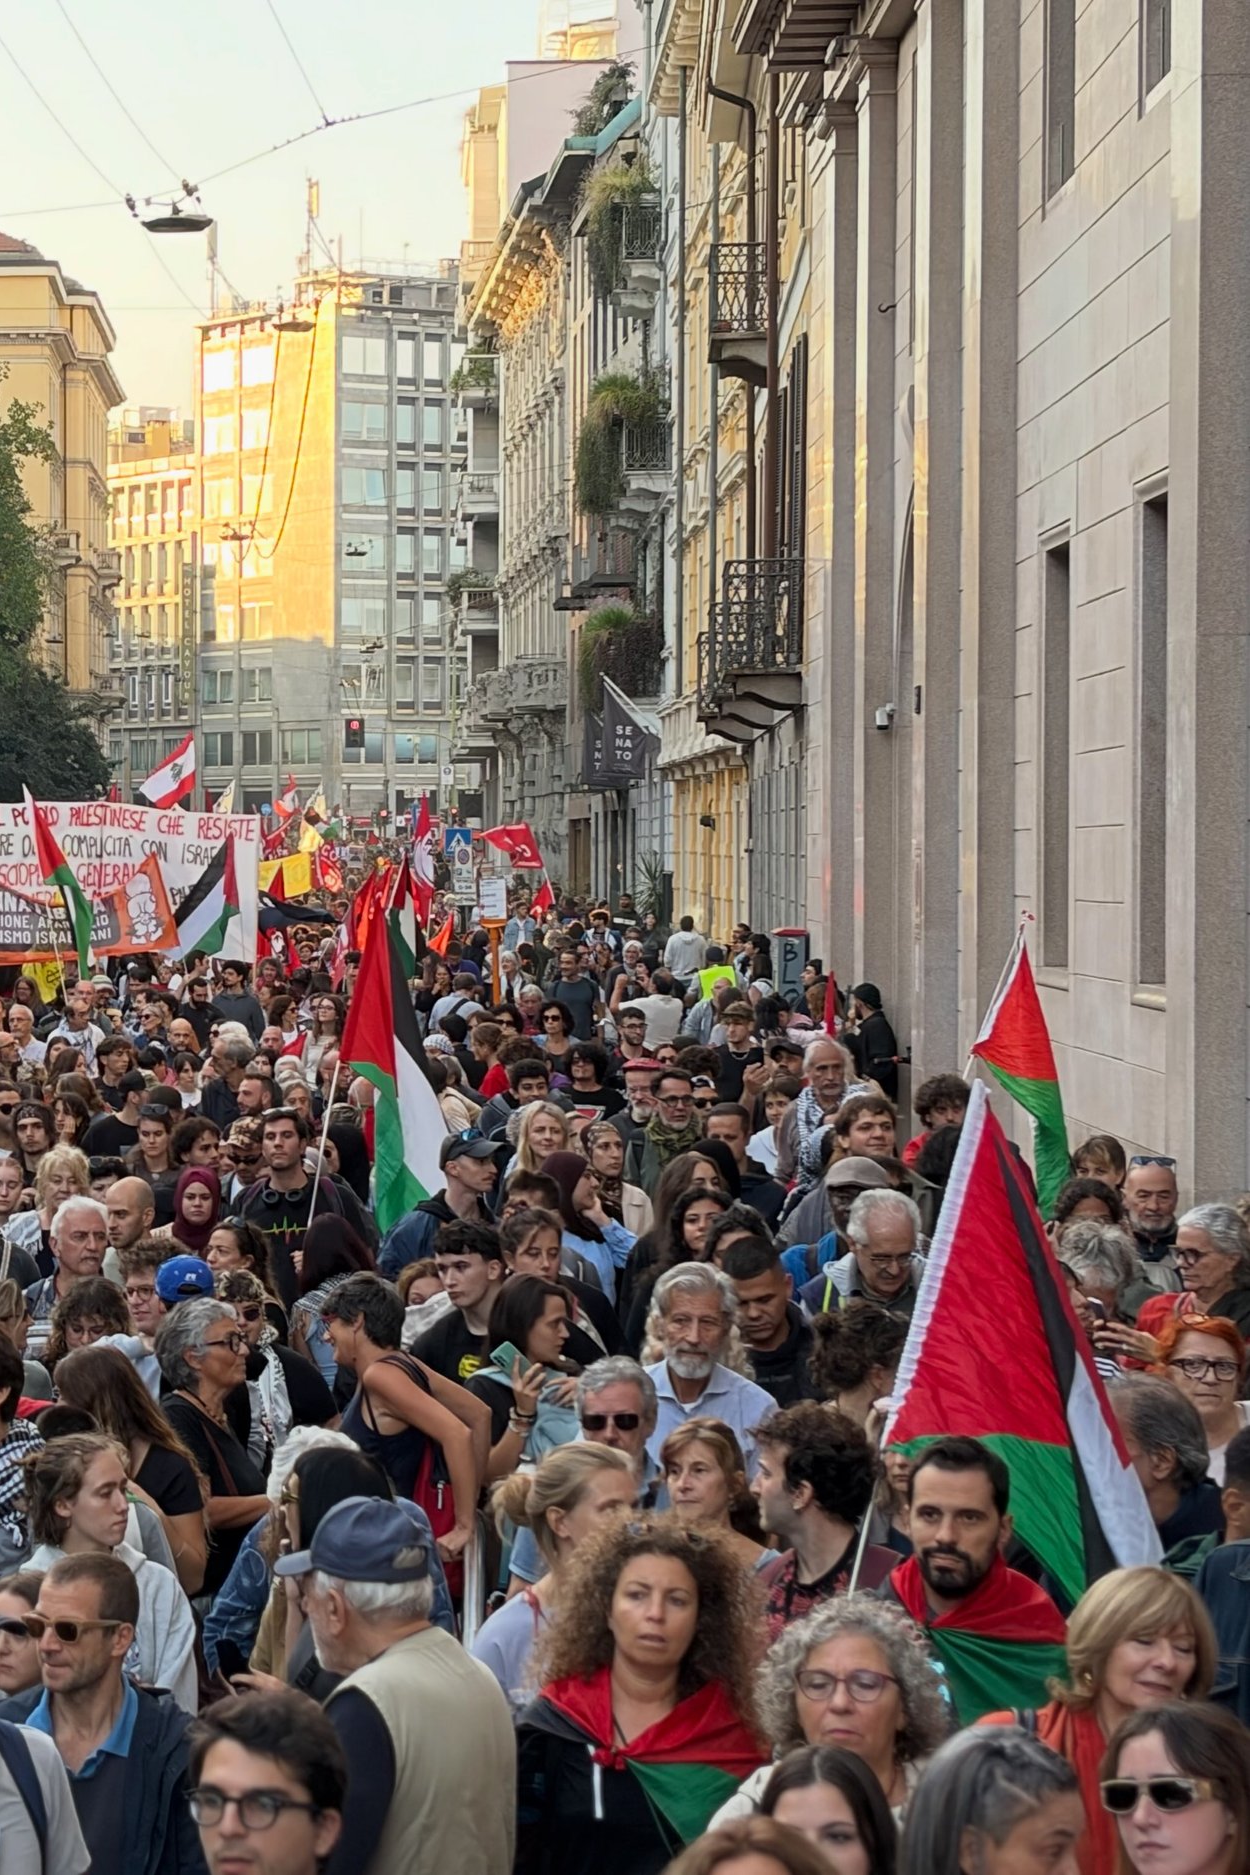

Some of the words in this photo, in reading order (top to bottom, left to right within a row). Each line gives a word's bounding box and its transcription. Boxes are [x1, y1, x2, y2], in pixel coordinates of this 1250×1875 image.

[615, 725, 633, 735] SE
[615, 738, 632, 748] NA
[615, 750, 632, 760] TO
[69, 803, 149, 832] PALESTINESE
[157, 814, 186, 836] CHE
[197, 816, 257, 842] RESISTE
[140, 838, 168, 863] CON
